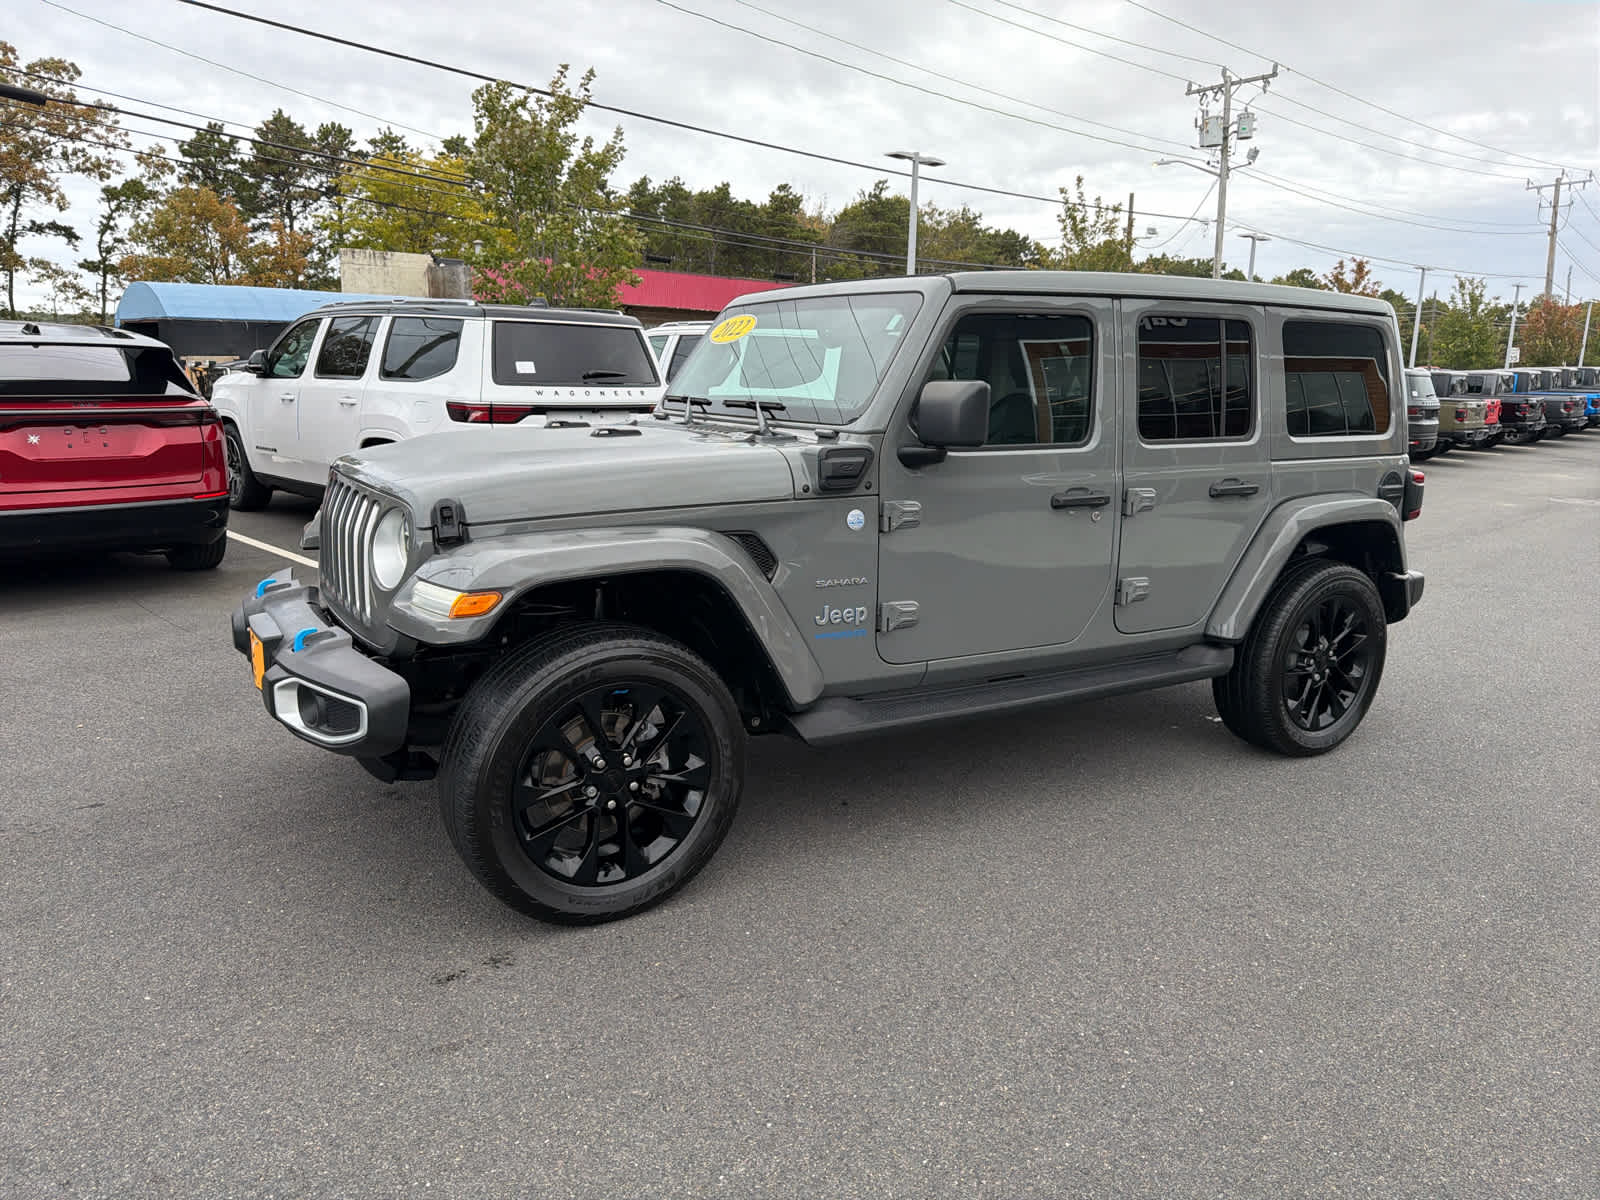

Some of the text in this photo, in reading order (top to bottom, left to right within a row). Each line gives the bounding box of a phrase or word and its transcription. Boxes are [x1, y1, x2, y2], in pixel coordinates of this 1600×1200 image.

[713, 319, 752, 338] 2022
[815, 577, 868, 588] SAHARA
[815, 604, 868, 626] Jeep
